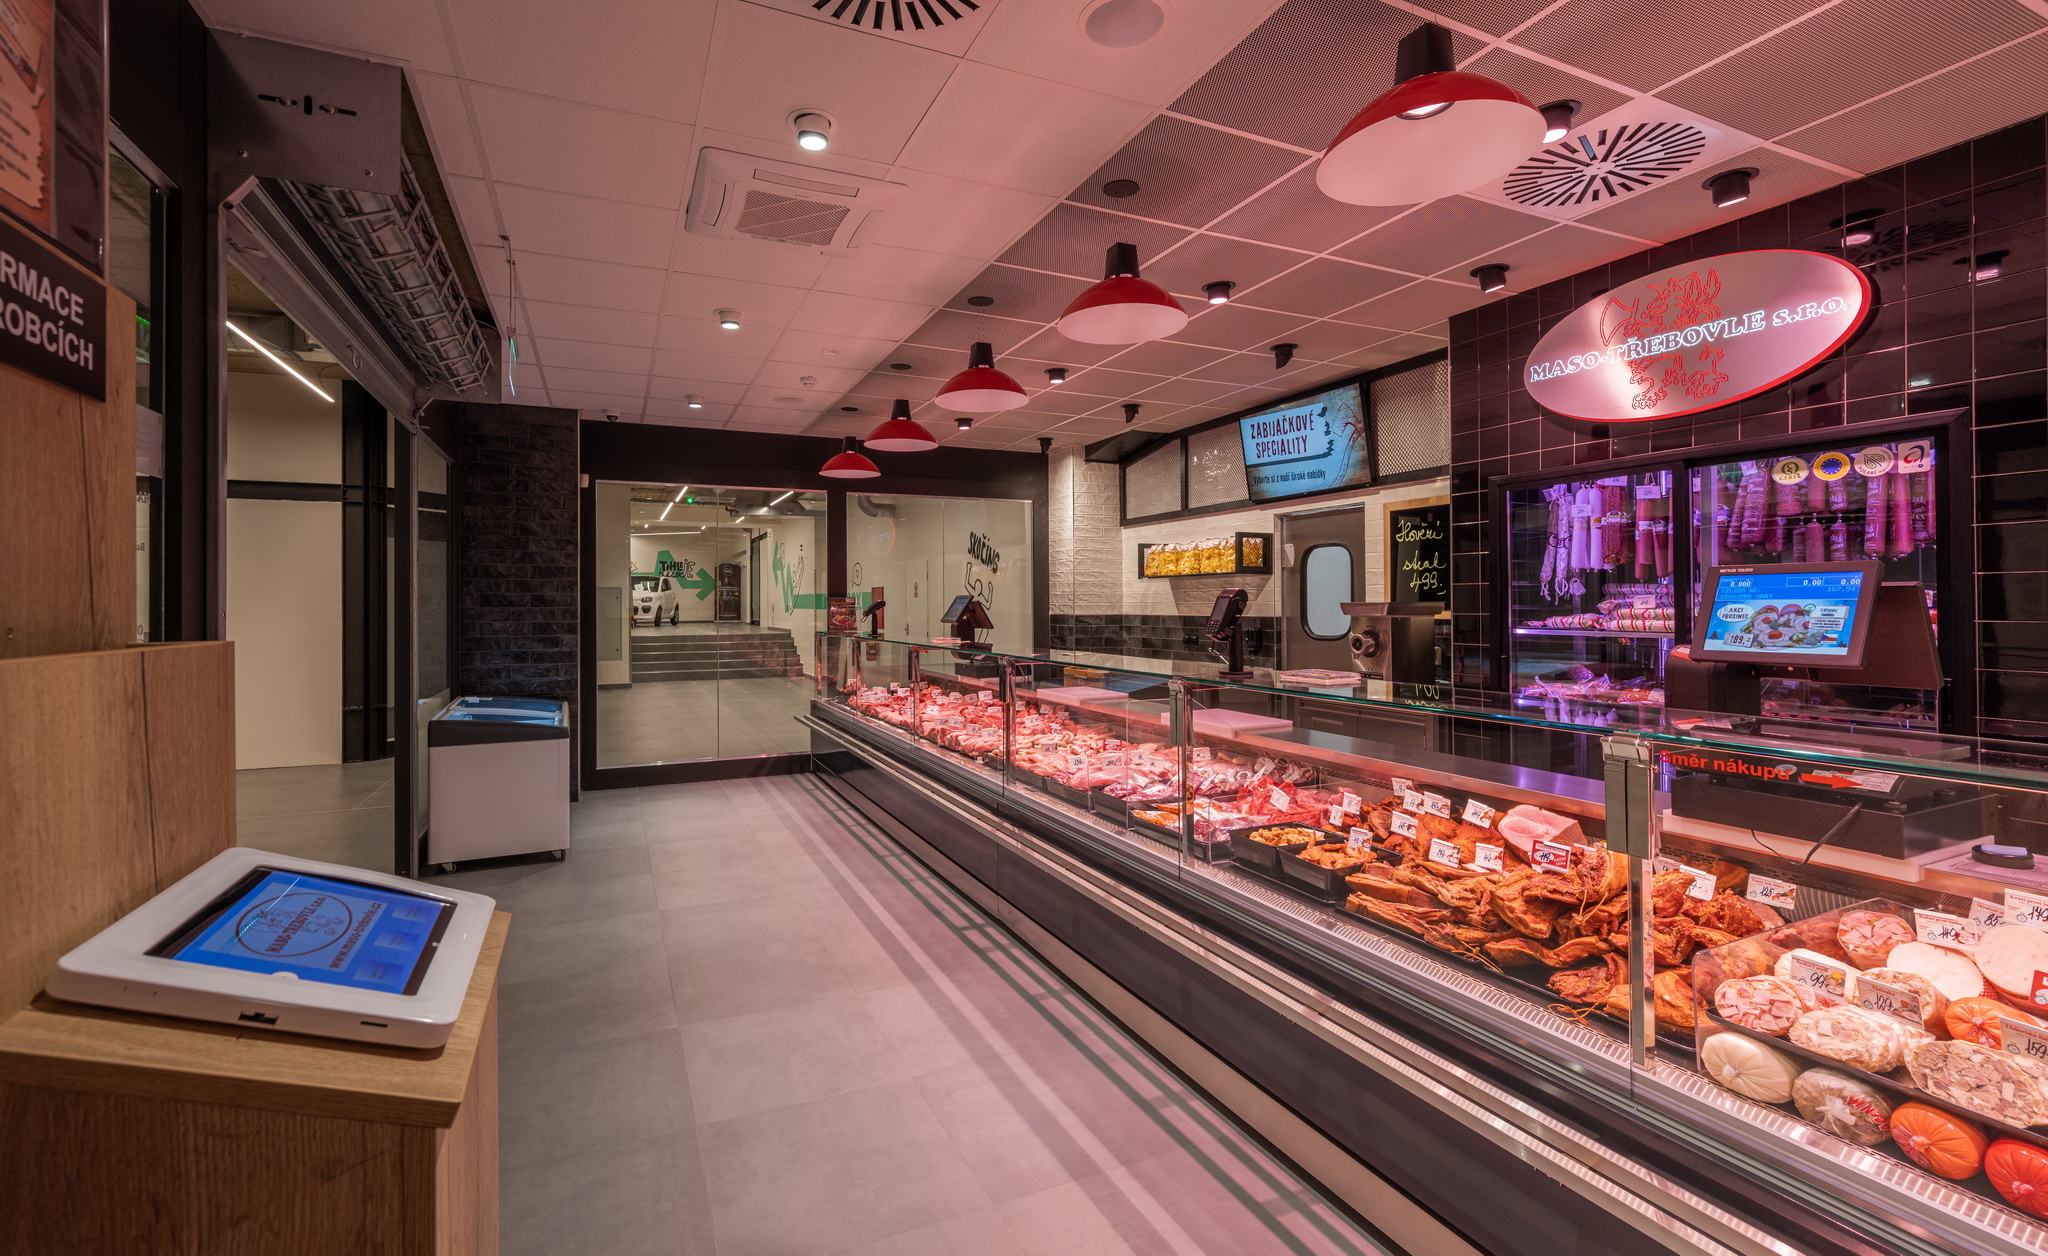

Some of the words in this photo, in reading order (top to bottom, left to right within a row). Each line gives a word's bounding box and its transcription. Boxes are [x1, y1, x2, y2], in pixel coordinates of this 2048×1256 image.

[0, 298, 93, 371] OBCÍCH
[1530, 310, 1766, 382] MASO-TŘEBOVLE
[1250, 409, 1314, 439] ZABIJAČKOVÉ
[1255, 435, 1308, 459] SPECIALITY
[1253, 475, 1270, 486] Vyberte
[1280, 471, 1290, 482] naši
[1291, 470, 1306, 481] široké
[1306, 468, 1326, 480] nabídky
[1659, 749, 1708, 769] Směr
[1713, 759, 1792, 781] nákupu
